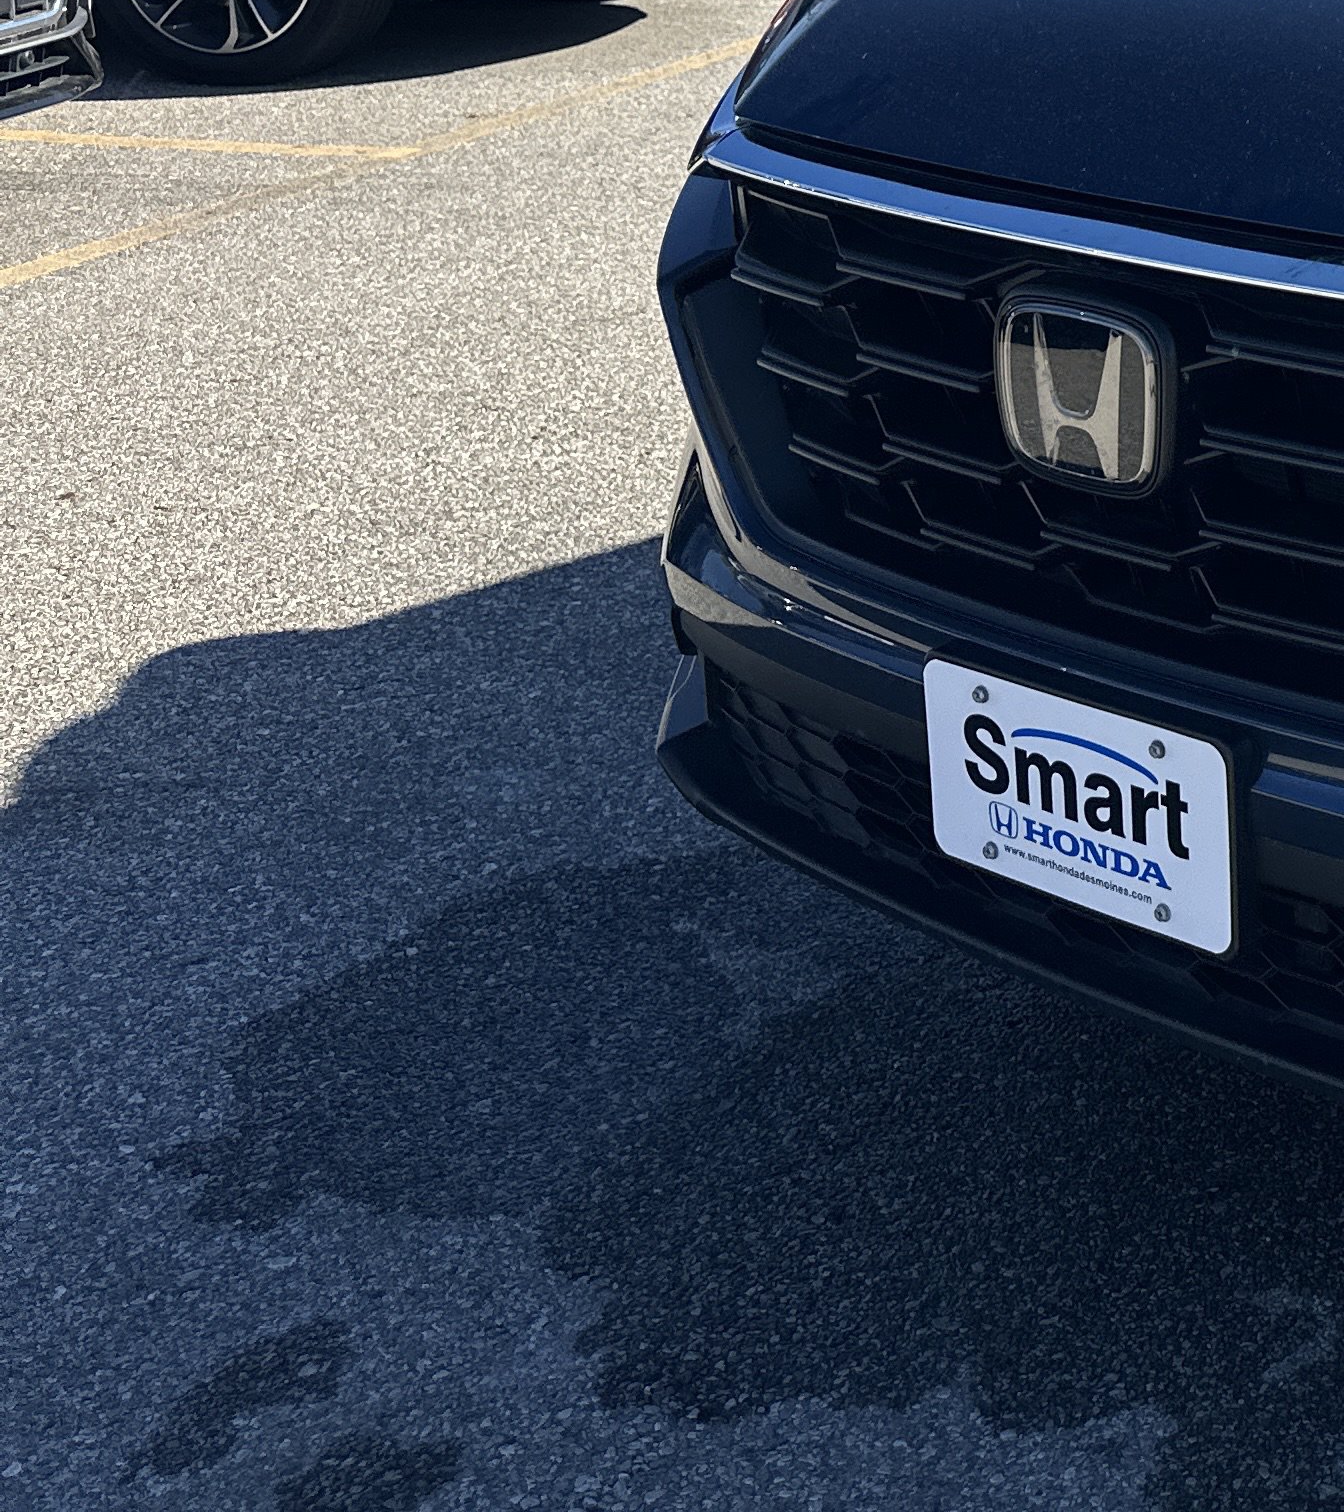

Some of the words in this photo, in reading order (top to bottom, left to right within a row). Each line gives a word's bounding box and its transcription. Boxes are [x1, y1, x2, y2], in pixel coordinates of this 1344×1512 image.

[963, 713, 1190, 861] Smart
[1003, 843, 1153, 905] www.smarthondadesmoines.com
[1023, 816, 1172, 891] HONDA
